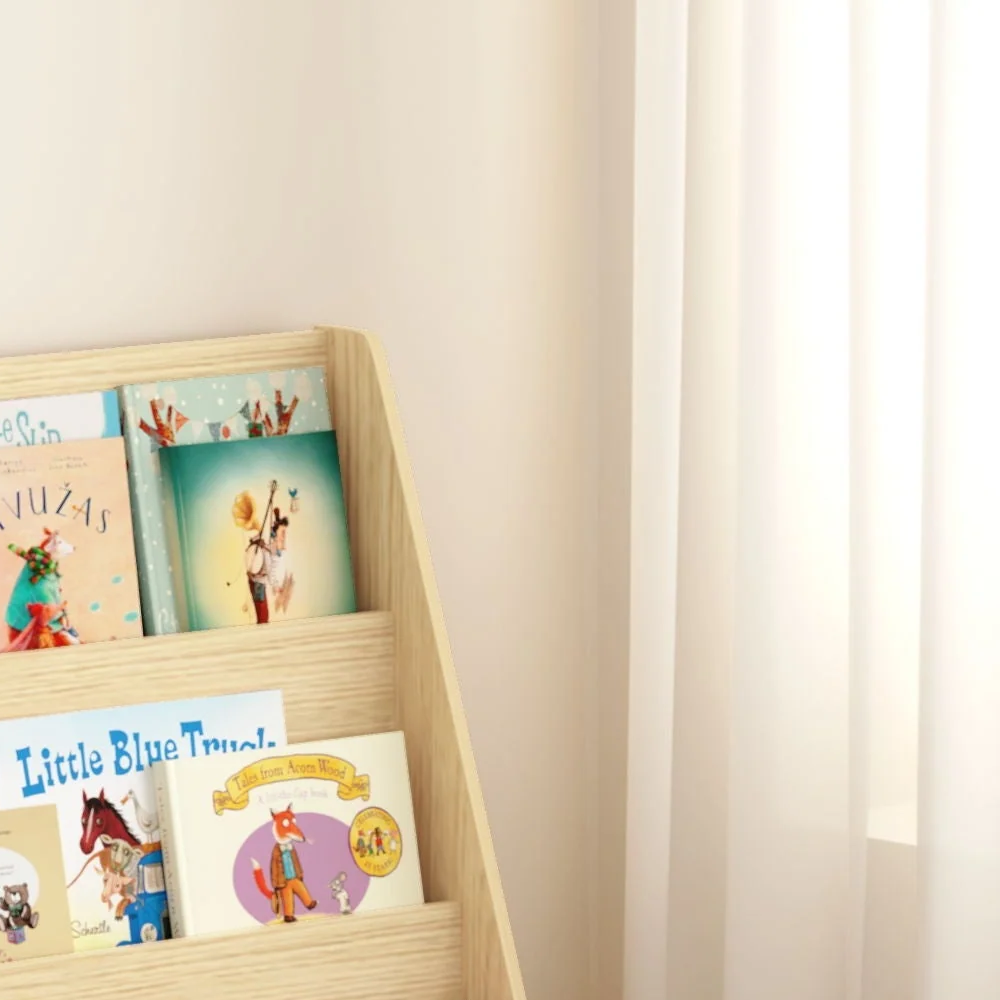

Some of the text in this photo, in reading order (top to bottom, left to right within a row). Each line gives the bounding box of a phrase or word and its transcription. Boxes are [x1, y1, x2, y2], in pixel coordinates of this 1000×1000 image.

[16, 740, 104, 798] Little
[109, 730, 180, 776] Blue
[232, 758, 348, 791] Tales from Acorn Wood
